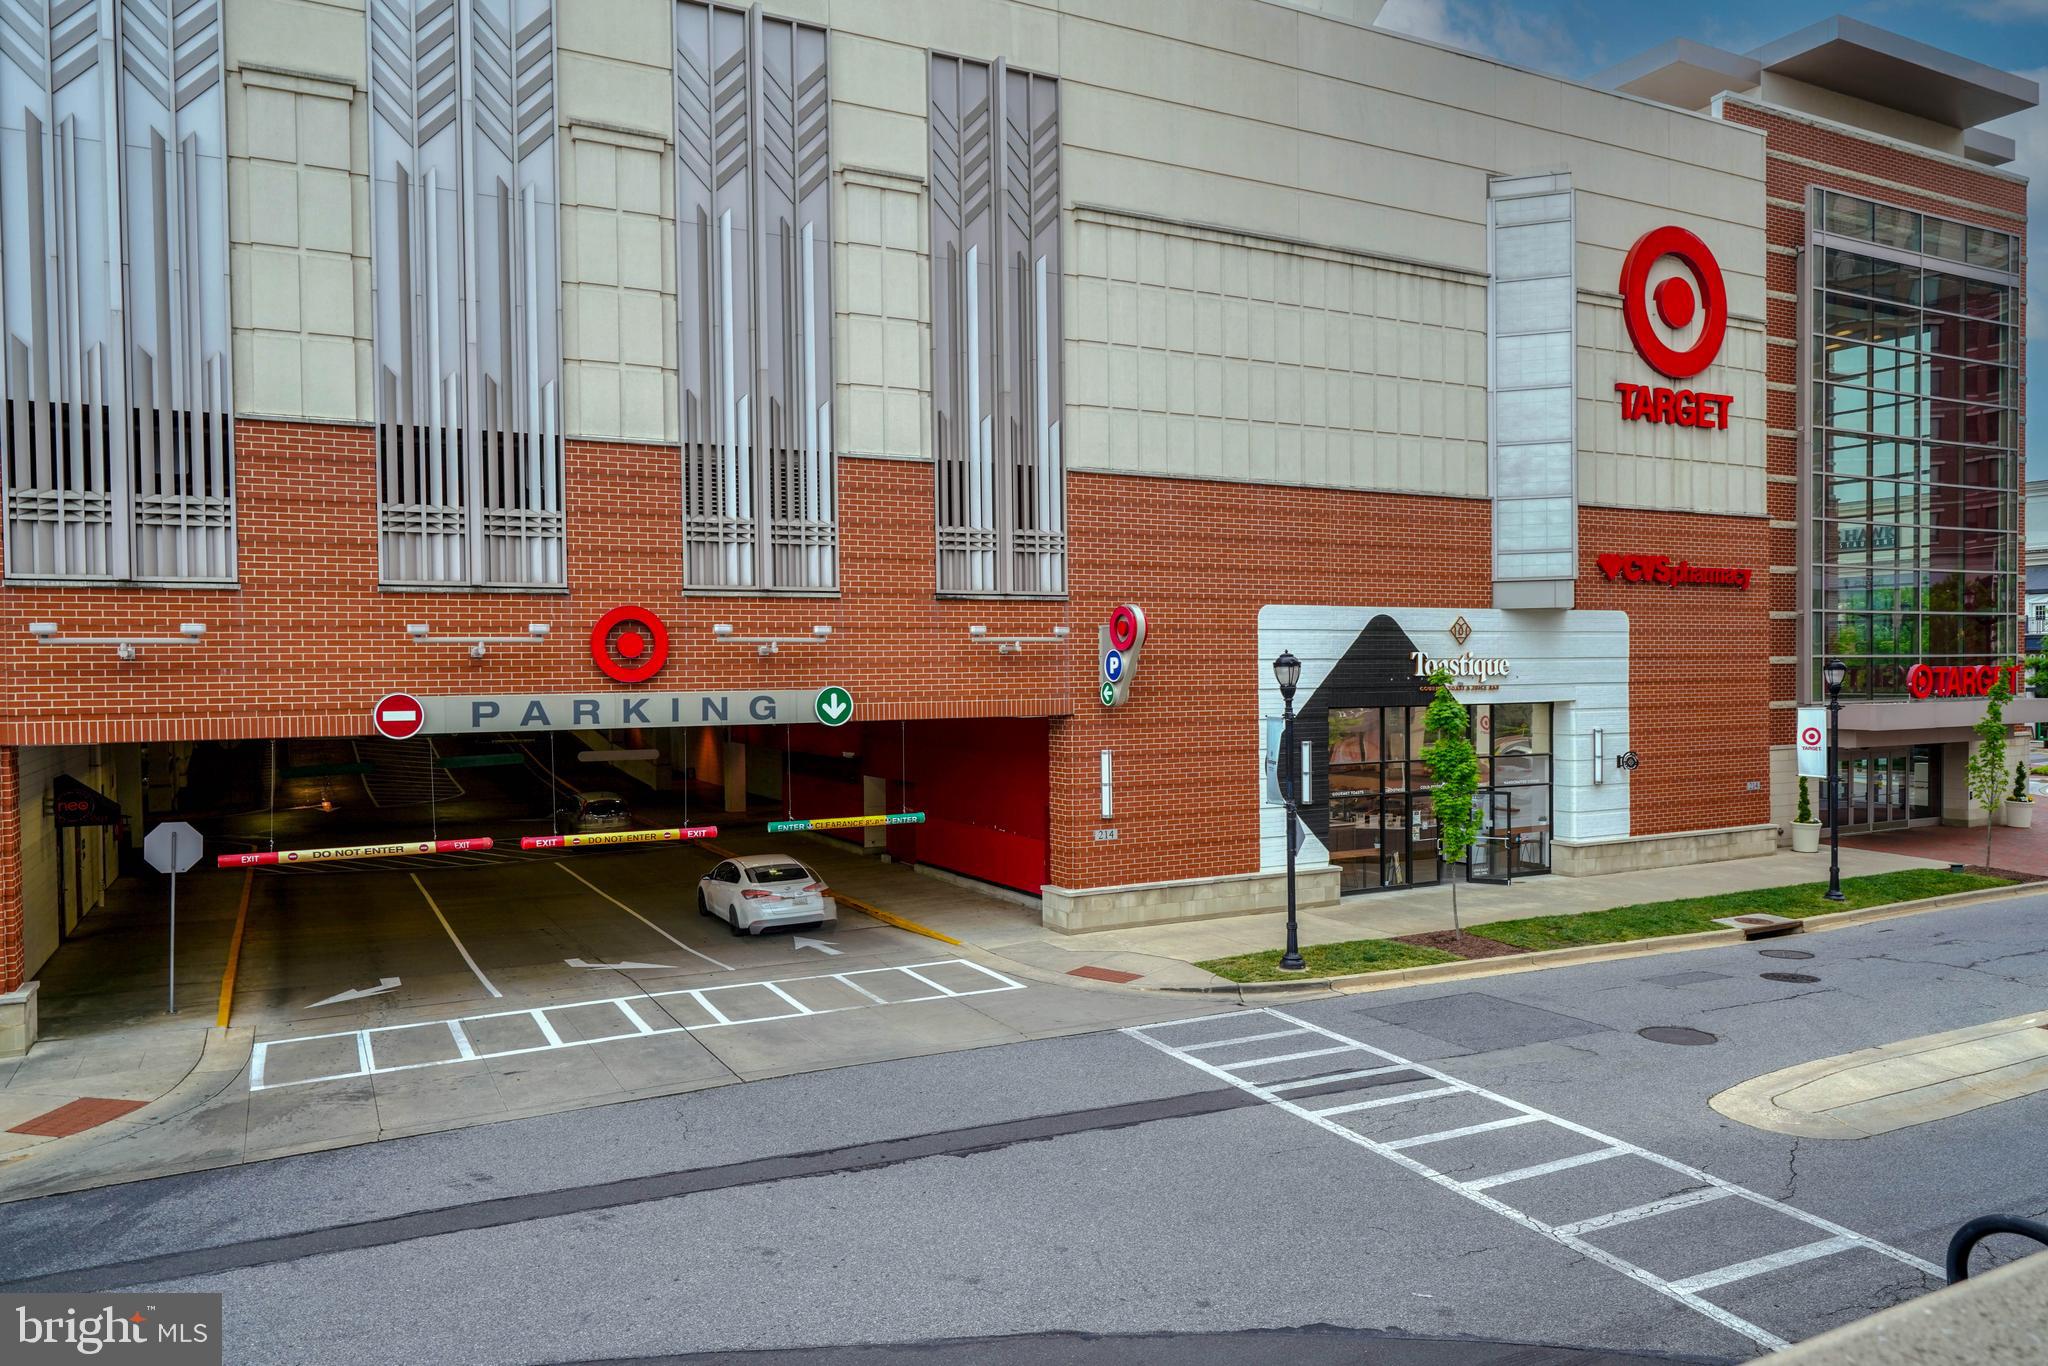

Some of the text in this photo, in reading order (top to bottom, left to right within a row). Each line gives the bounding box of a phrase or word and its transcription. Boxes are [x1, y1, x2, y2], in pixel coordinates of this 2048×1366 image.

[1615, 383, 1734, 430] TARGET
[1109, 656, 1119, 674] P
[1410, 651, 1510, 682] Toastique
[471, 695, 777, 728] PARKING
[777, 823, 804, 831] ENTER
[815, 820, 864, 829] CLEARANCE
[892, 816, 918, 824] ENTER
[535, 839, 557, 848] EXIT
[604, 835, 623, 843] NOT
[627, 833, 657, 842] ENTER
[687, 829, 707, 838] EXIT
[1098, 830, 1114, 839] 214
[241, 841, 470, 864] EXIT DO NOT ENTER EXIT
